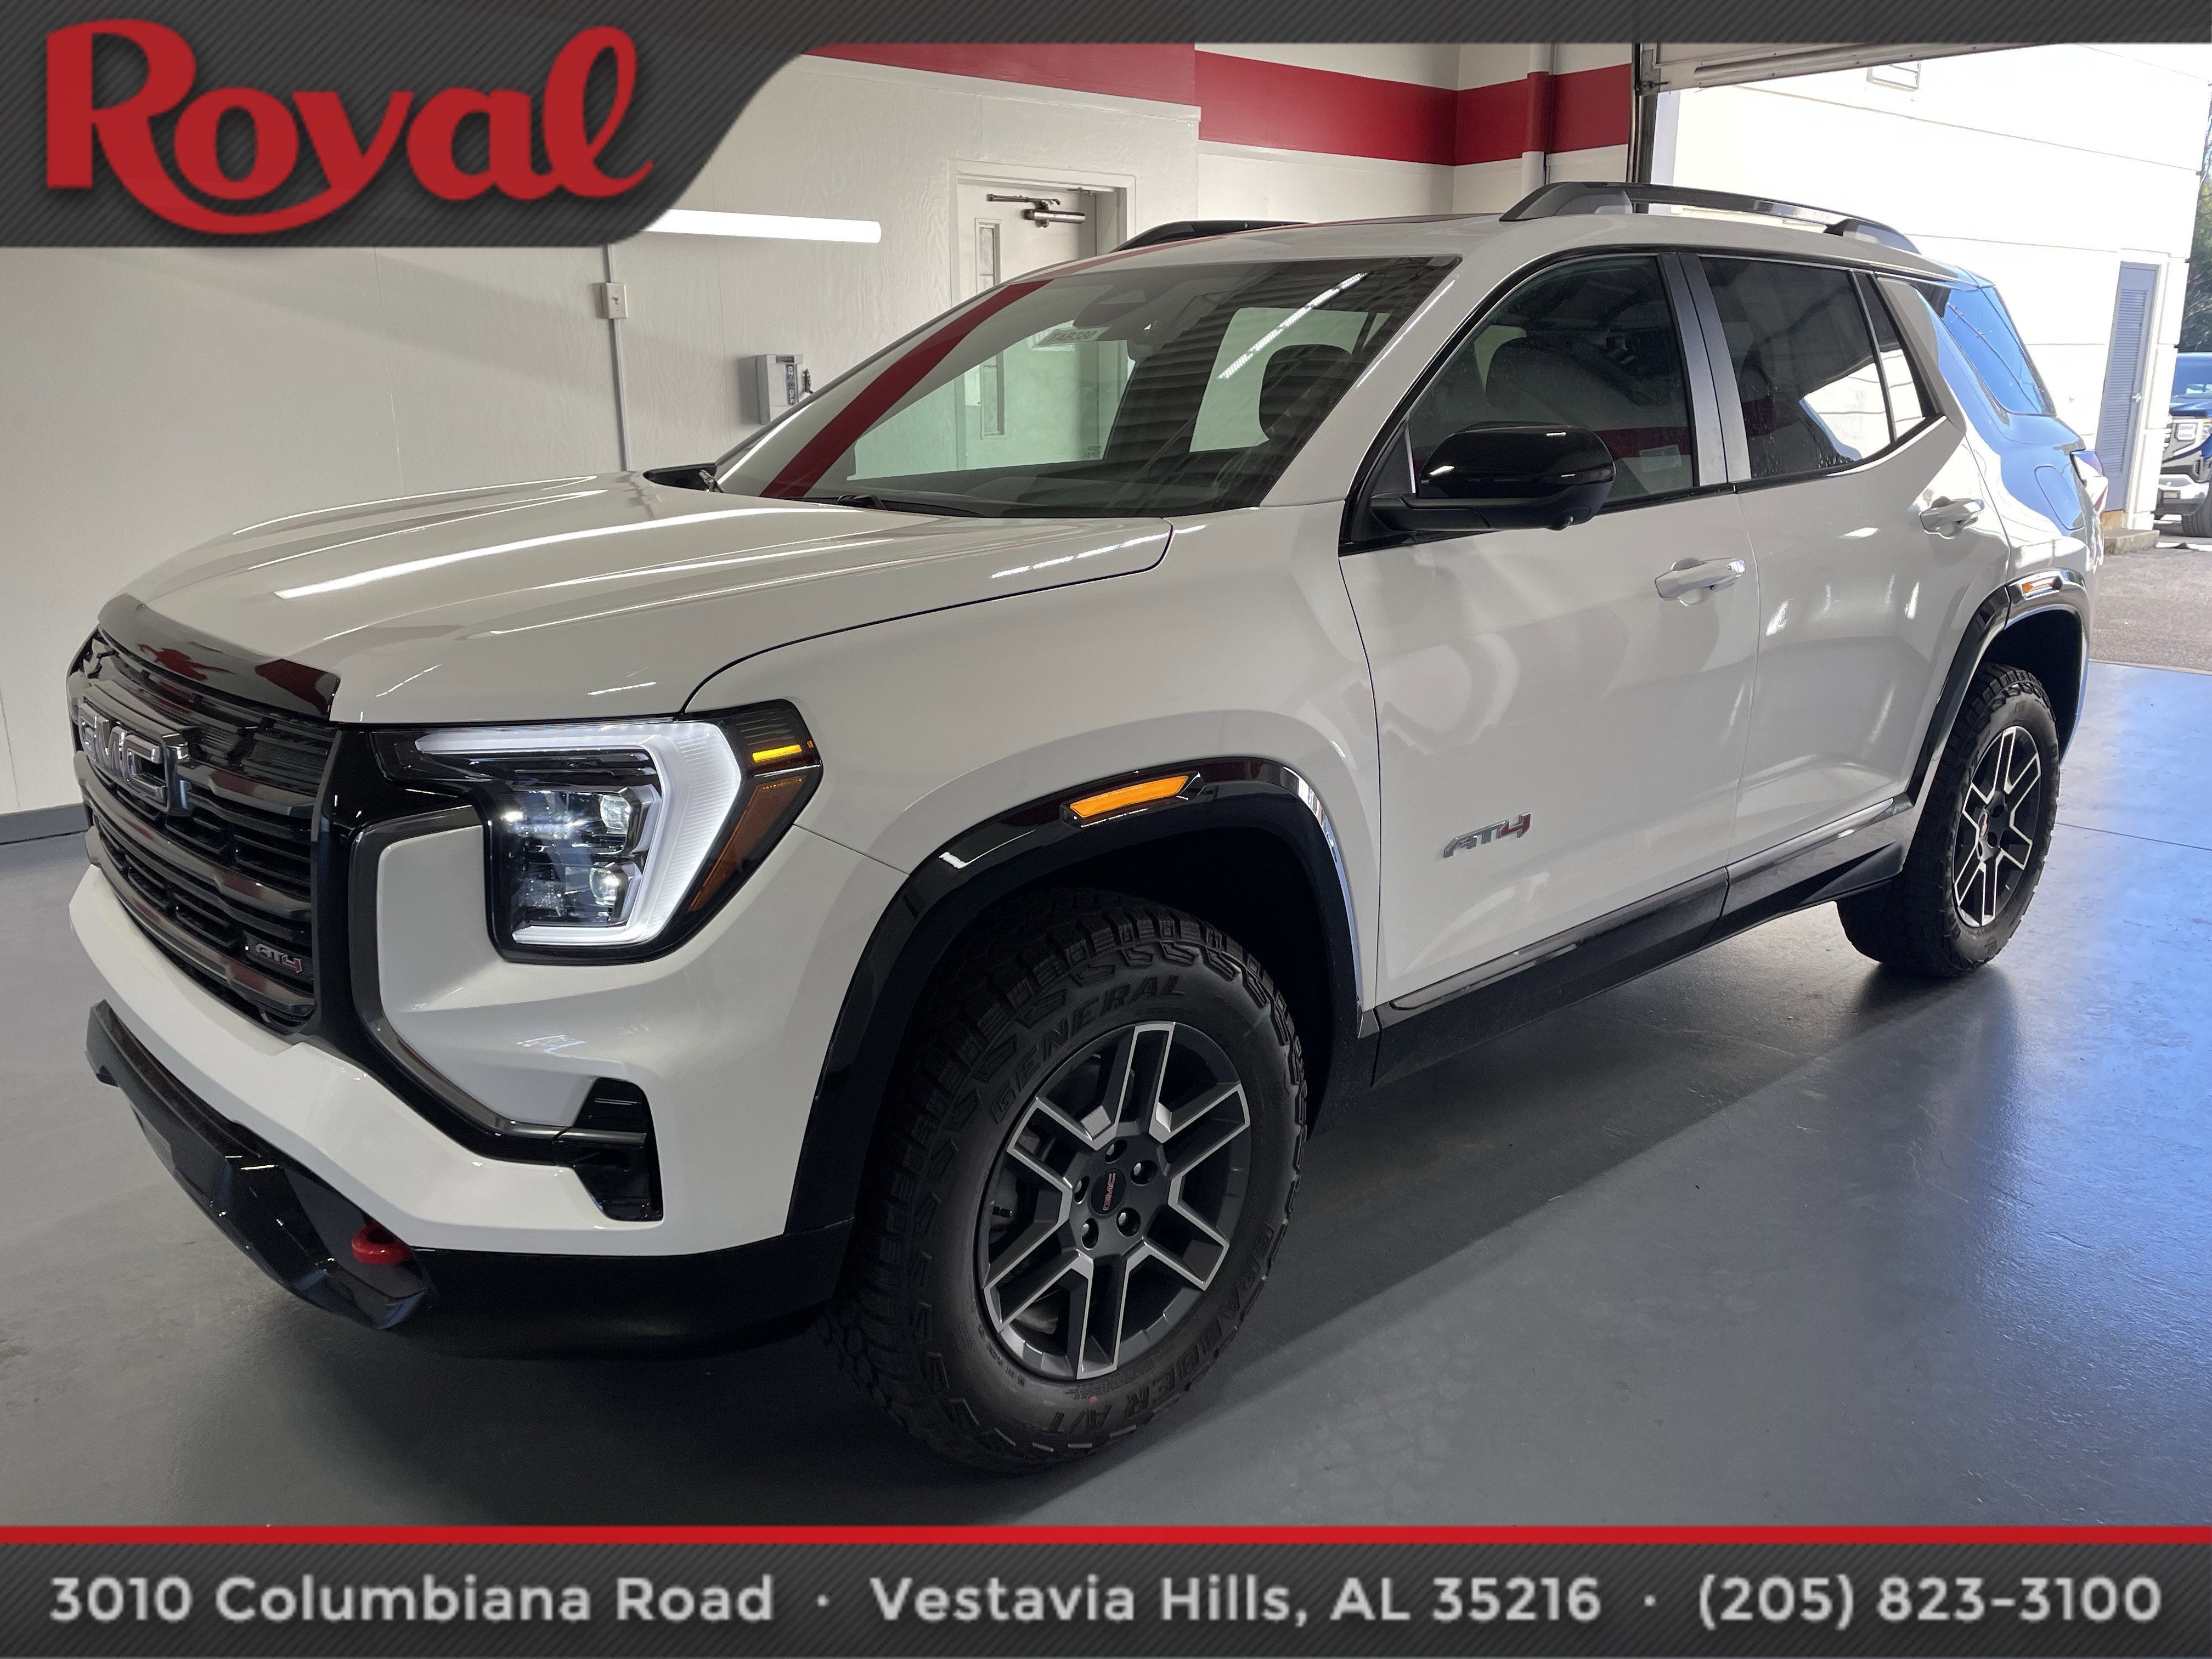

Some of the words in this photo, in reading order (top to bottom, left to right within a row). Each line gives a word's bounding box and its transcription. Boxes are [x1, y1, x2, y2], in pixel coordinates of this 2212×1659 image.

[1443, 811, 1532, 859] AT4
[255, 943, 302, 973] AT4
[990, 974, 1186, 1125] GENERAL
[1103, 1173, 1116, 1211] GMC
